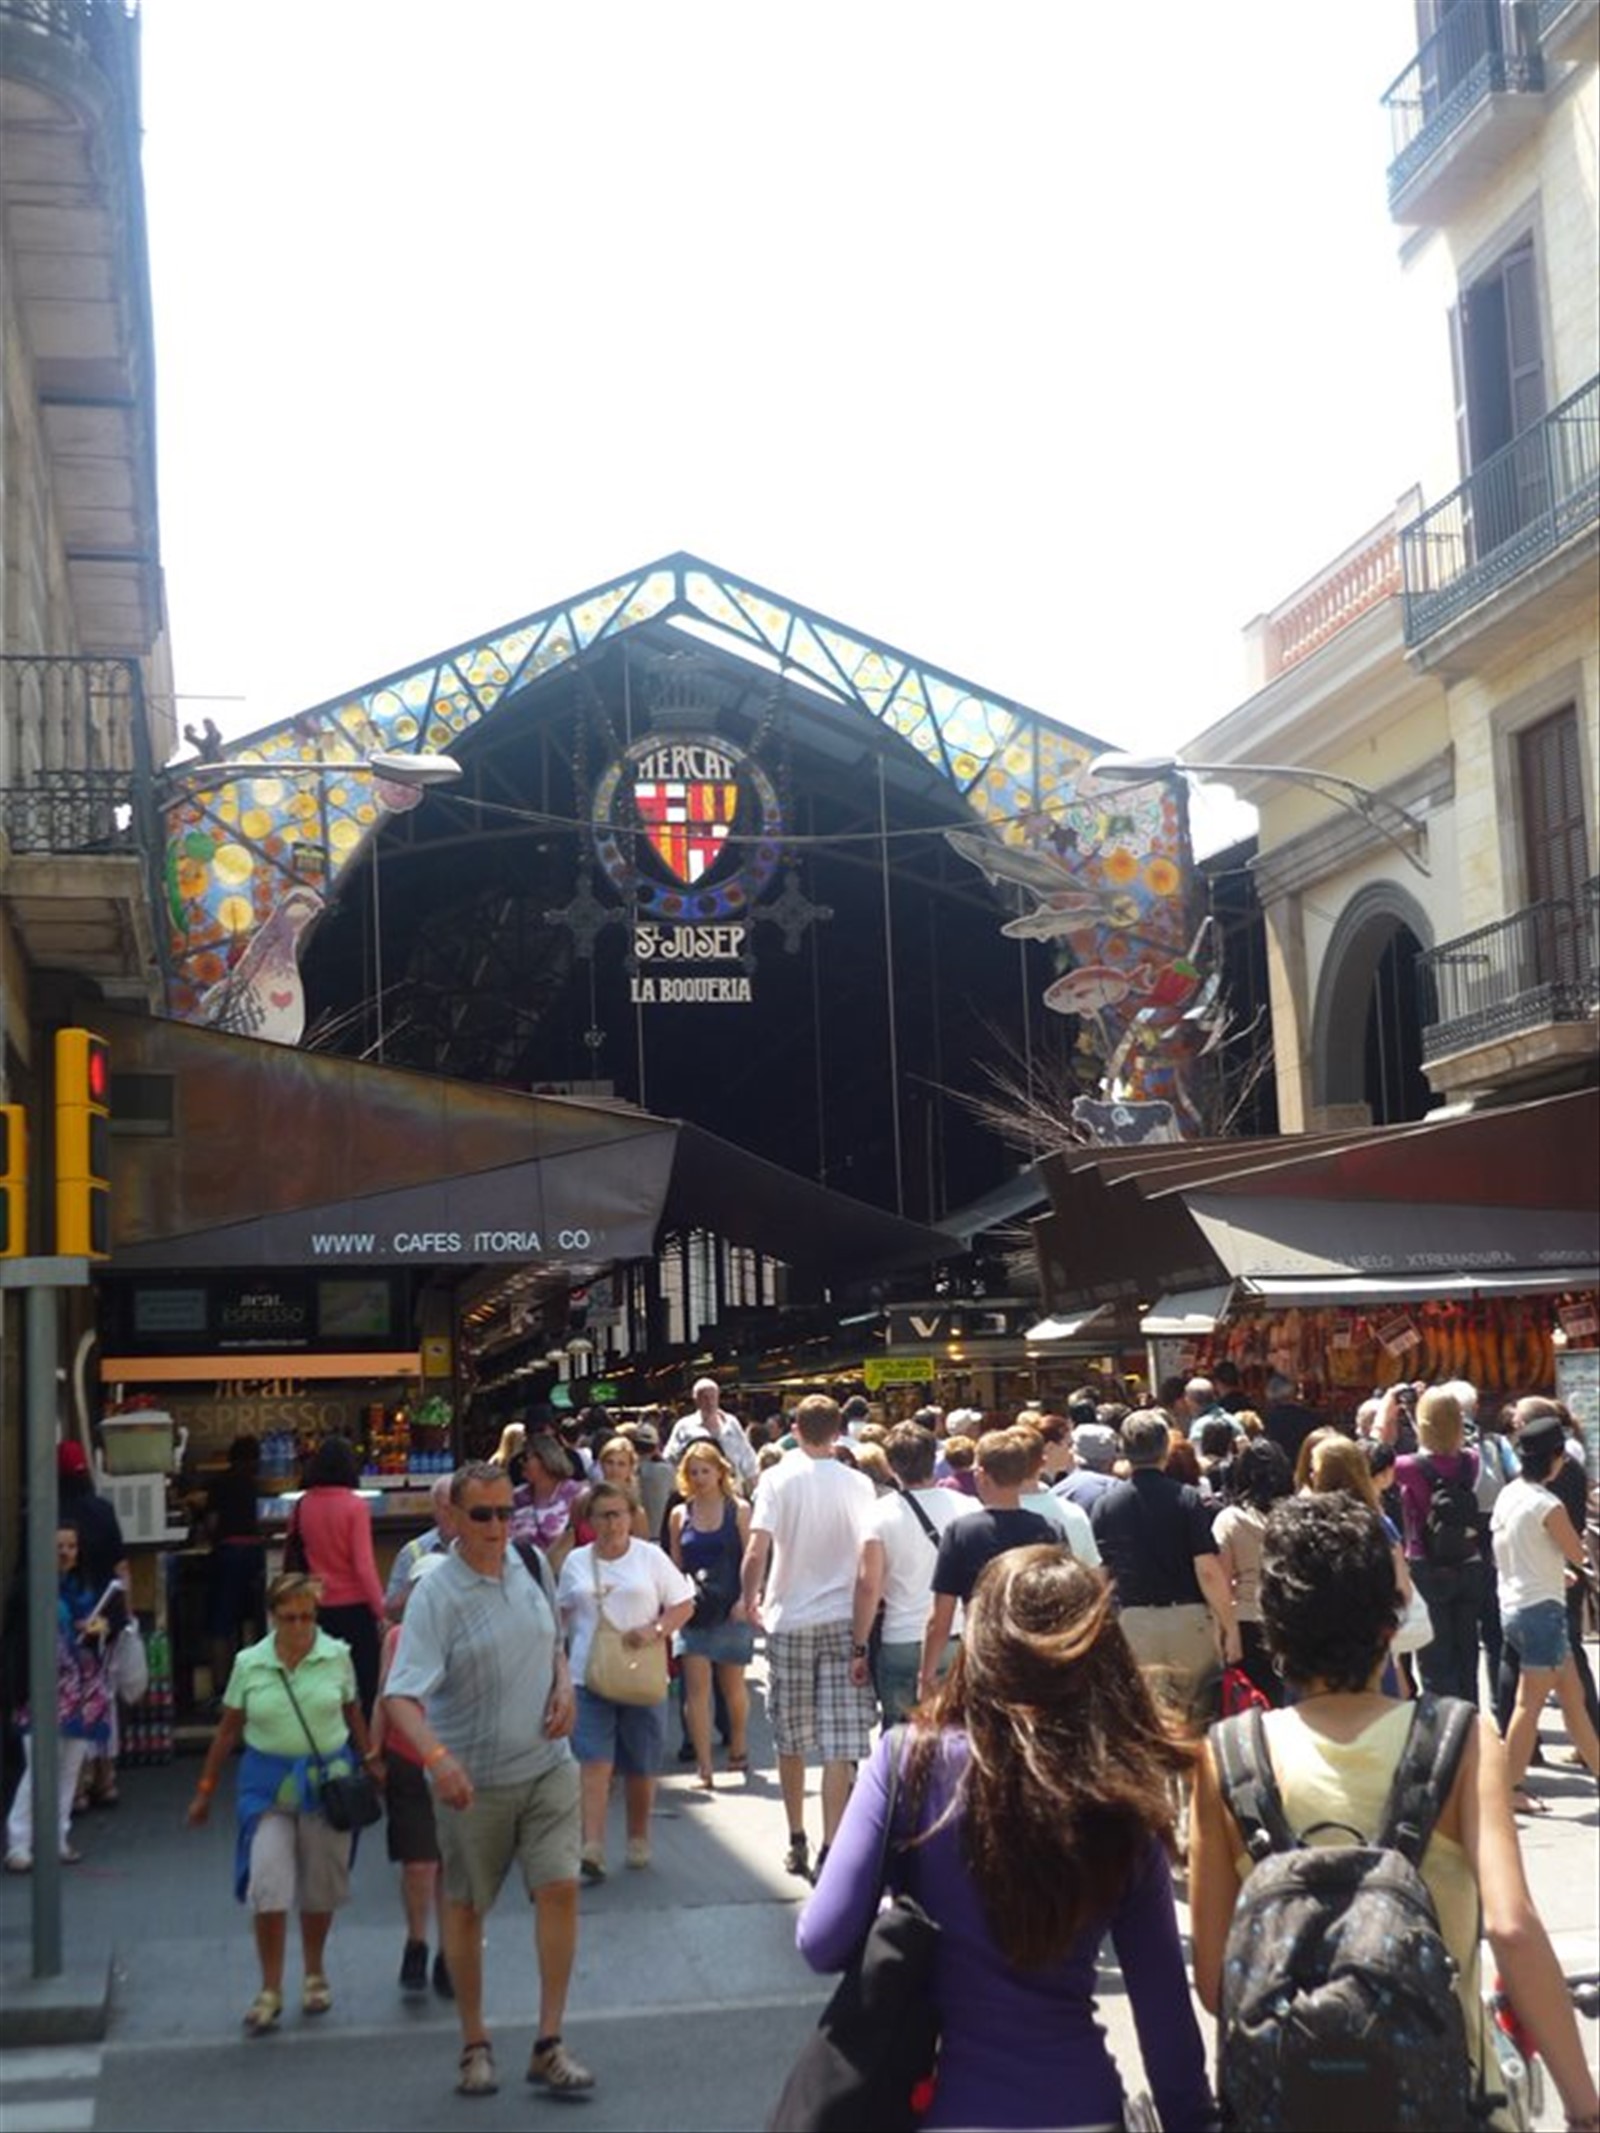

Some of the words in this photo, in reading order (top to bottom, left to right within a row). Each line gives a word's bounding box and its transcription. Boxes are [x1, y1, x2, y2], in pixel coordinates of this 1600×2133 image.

[638, 746, 735, 779] MERCAT
[660, 926, 745, 957] JOSEP
[631, 978, 655, 1001] LA
[660, 978, 751, 1001] BOQUERIA
[394, 1233, 461, 1251] CAFES
[475, 1231, 541, 1251] ITORIA
[558, 1230, 590, 1250] CO
[223, 1306, 304, 1323] ESPRESSO
